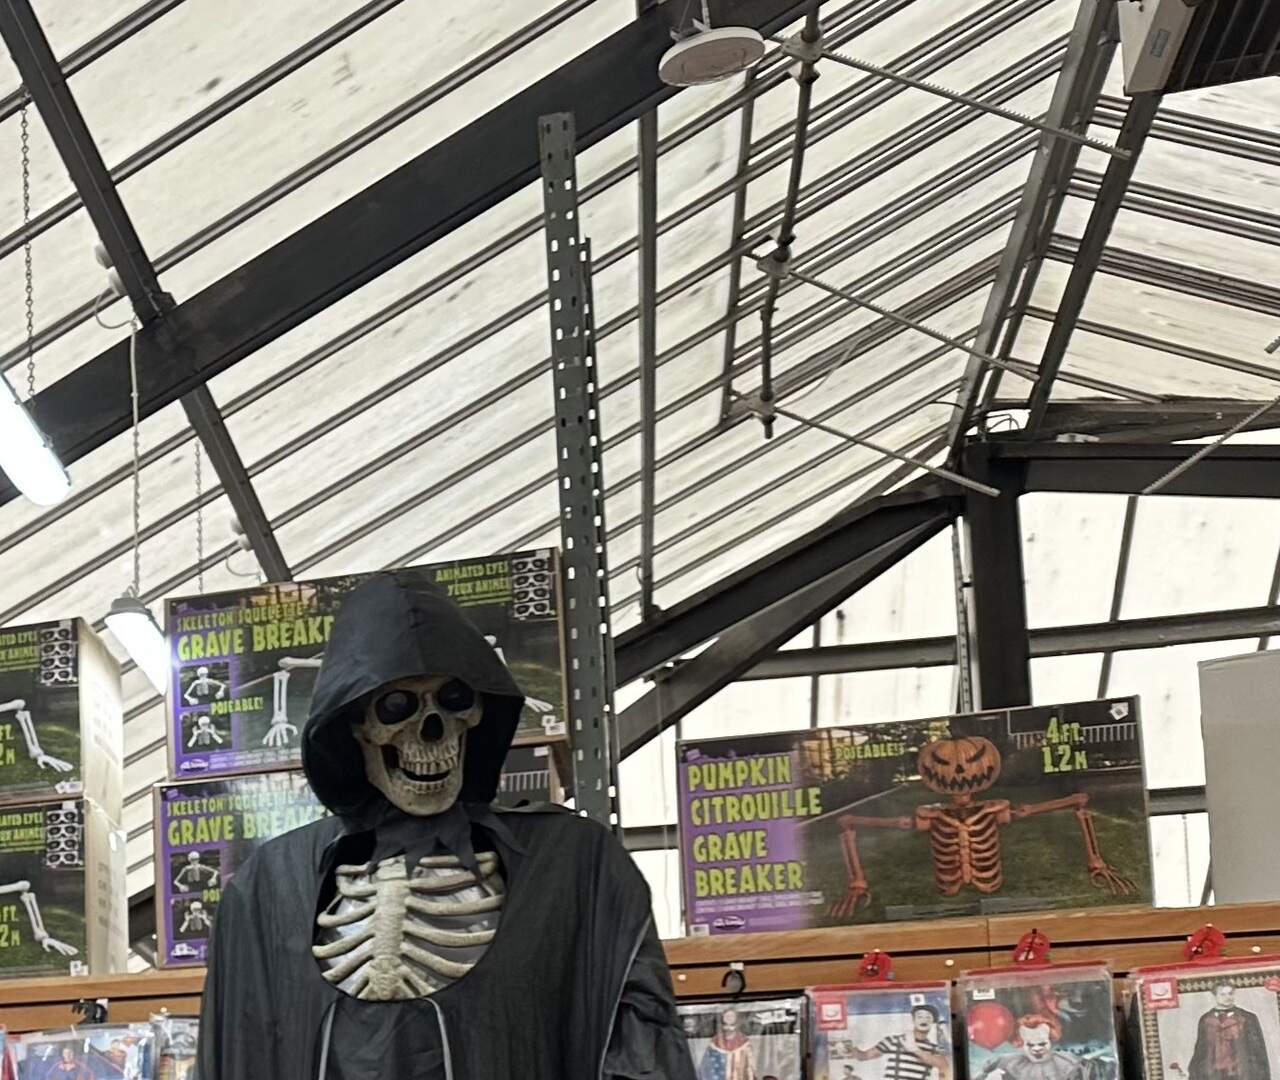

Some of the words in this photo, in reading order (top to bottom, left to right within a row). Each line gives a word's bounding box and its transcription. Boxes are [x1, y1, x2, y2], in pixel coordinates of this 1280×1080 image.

[436, 563, 484, 582] ANIMATED
[177, 612, 233, 631] SKELETON
[178, 628, 244, 661] GRAVE
[253, 615, 334, 652] BREAKE
[688, 756, 791, 791] PUMPKIN
[168, 798, 223, 816] SKELETON
[691, 787, 822, 826] CITROUILLE
[168, 815, 234, 846] GRAVE
[243, 805, 326, 839] BREAK
[693, 830, 767, 863] GRAVE
[695, 862, 803, 897] BREAKER
